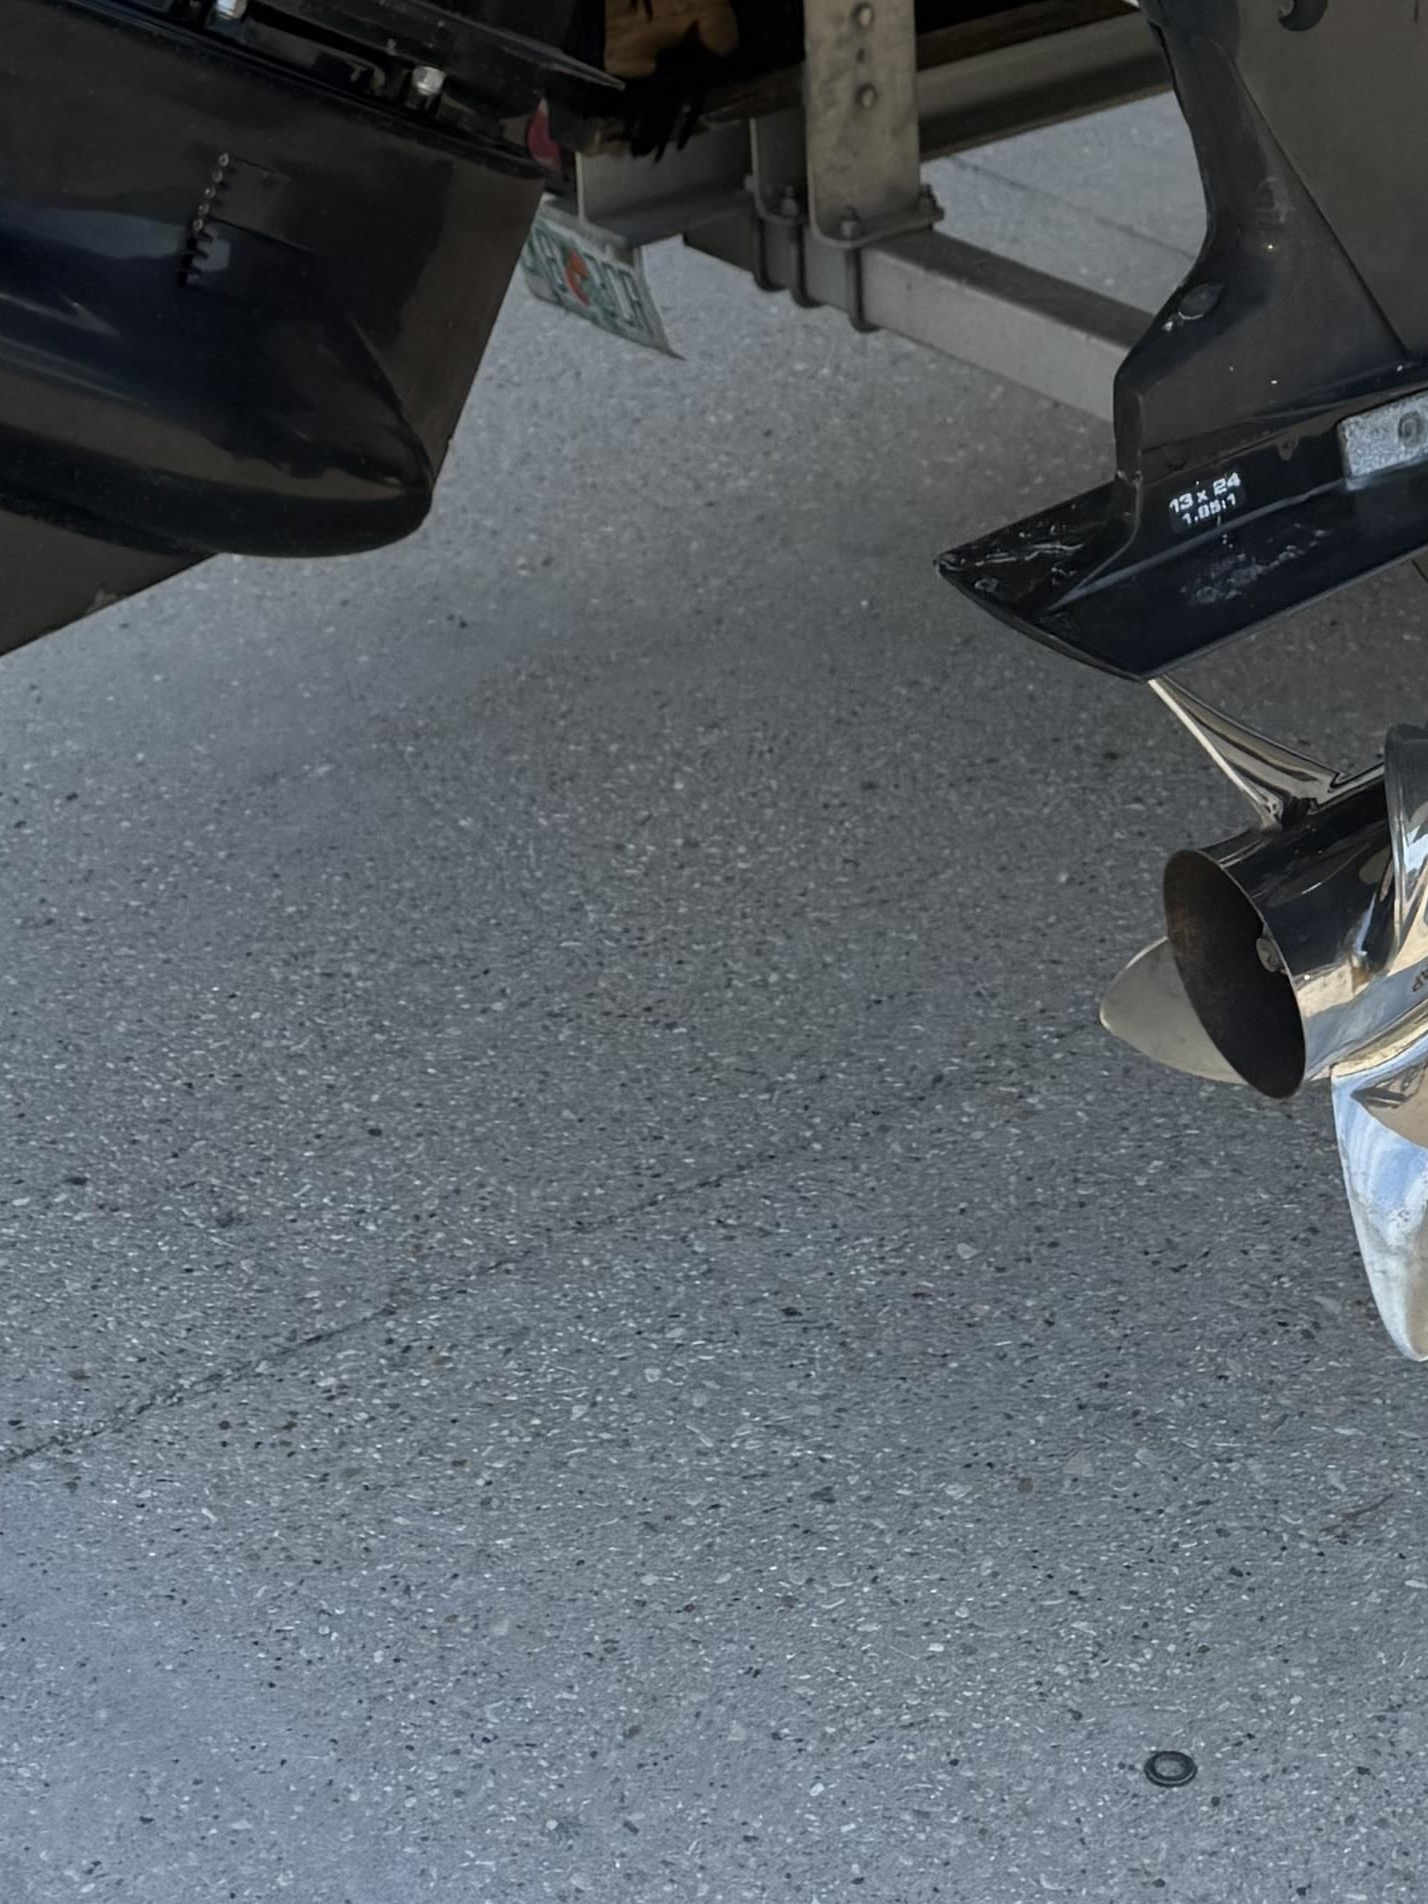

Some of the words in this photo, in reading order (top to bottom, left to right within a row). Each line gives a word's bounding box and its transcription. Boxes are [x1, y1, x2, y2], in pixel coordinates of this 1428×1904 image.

[1169, 493, 1193, 513] 13
[1196, 489, 1208, 503] x
[1212, 471, 1241, 496] 24
